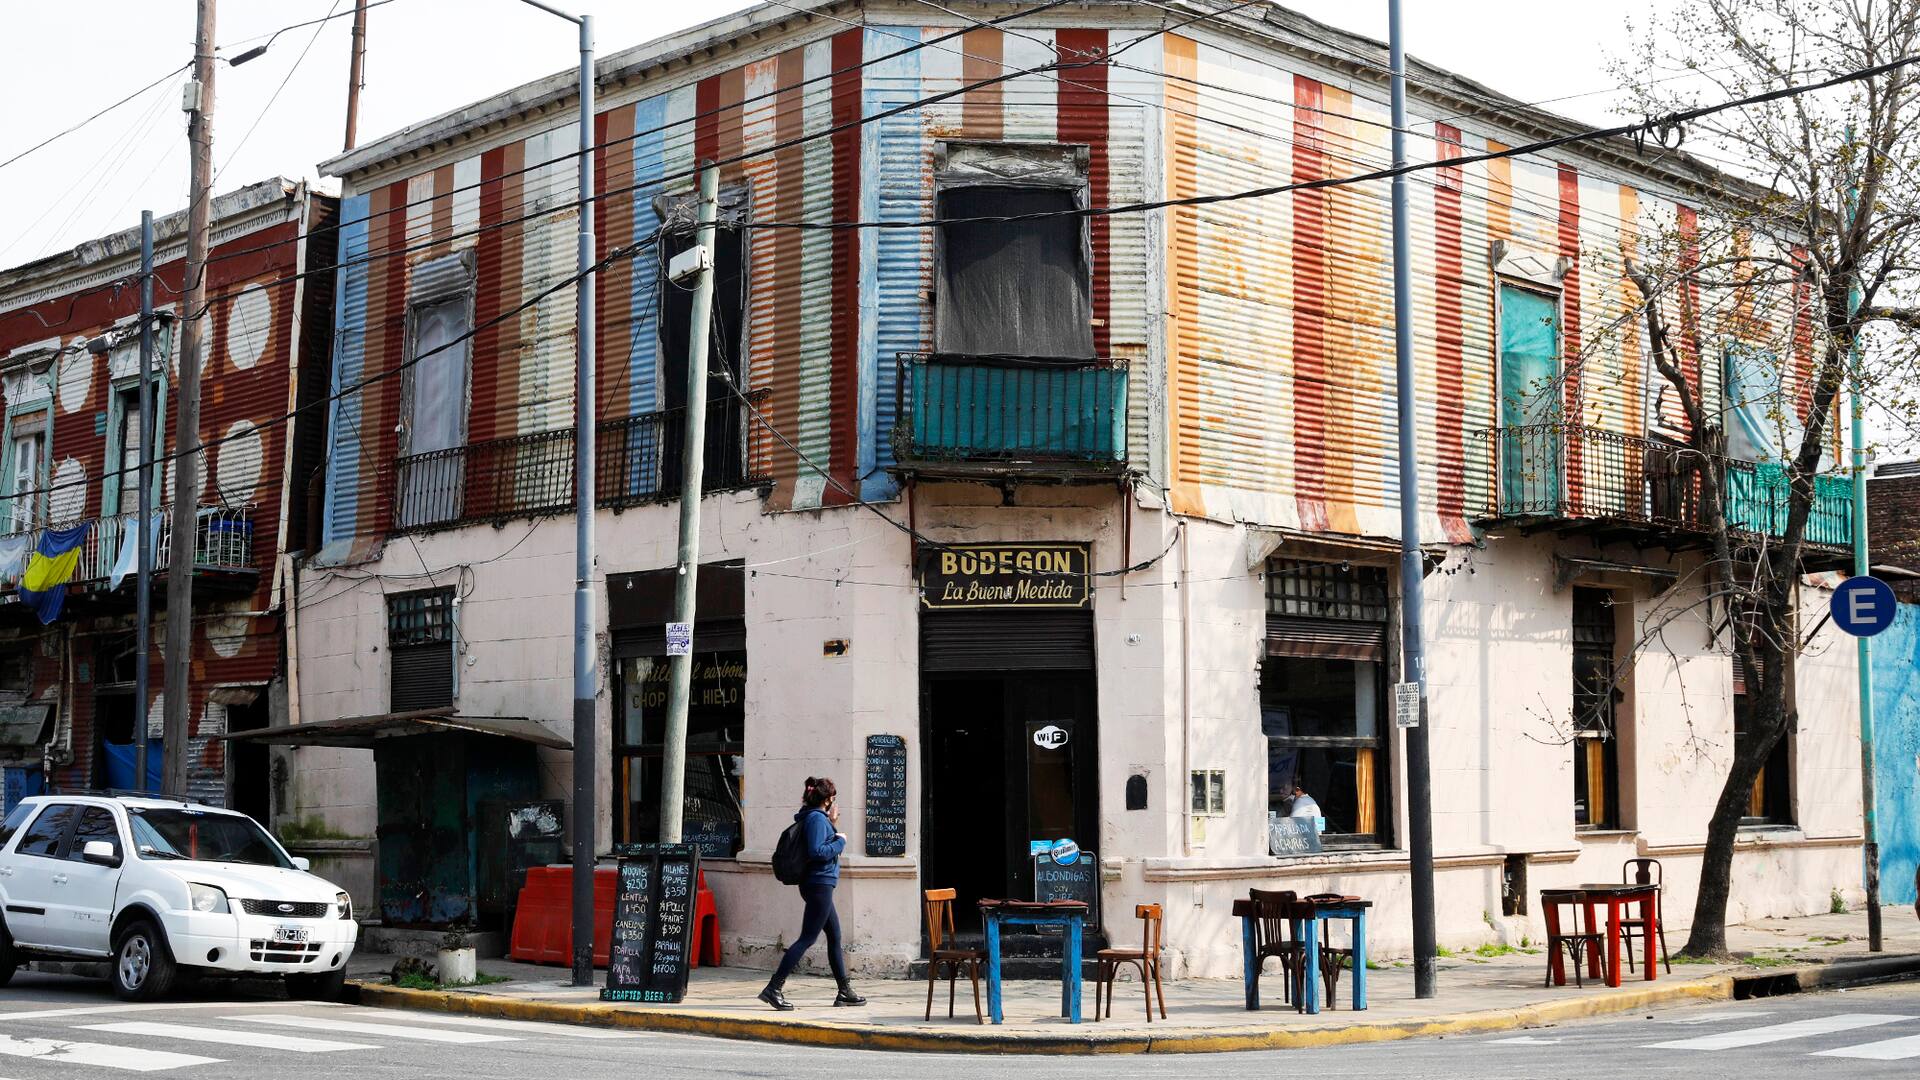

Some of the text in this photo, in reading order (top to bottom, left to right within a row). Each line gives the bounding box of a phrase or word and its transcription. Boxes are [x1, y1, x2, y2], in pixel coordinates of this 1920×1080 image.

[941, 551, 1071, 575] BODEGON
[942, 579, 1073, 602] La Buena Medida
[1848, 588, 1878, 624] E
[632, 691, 667, 709] CHOP
[703, 687, 738, 705] HIELO
[644, 990, 665, 1001] BEER
